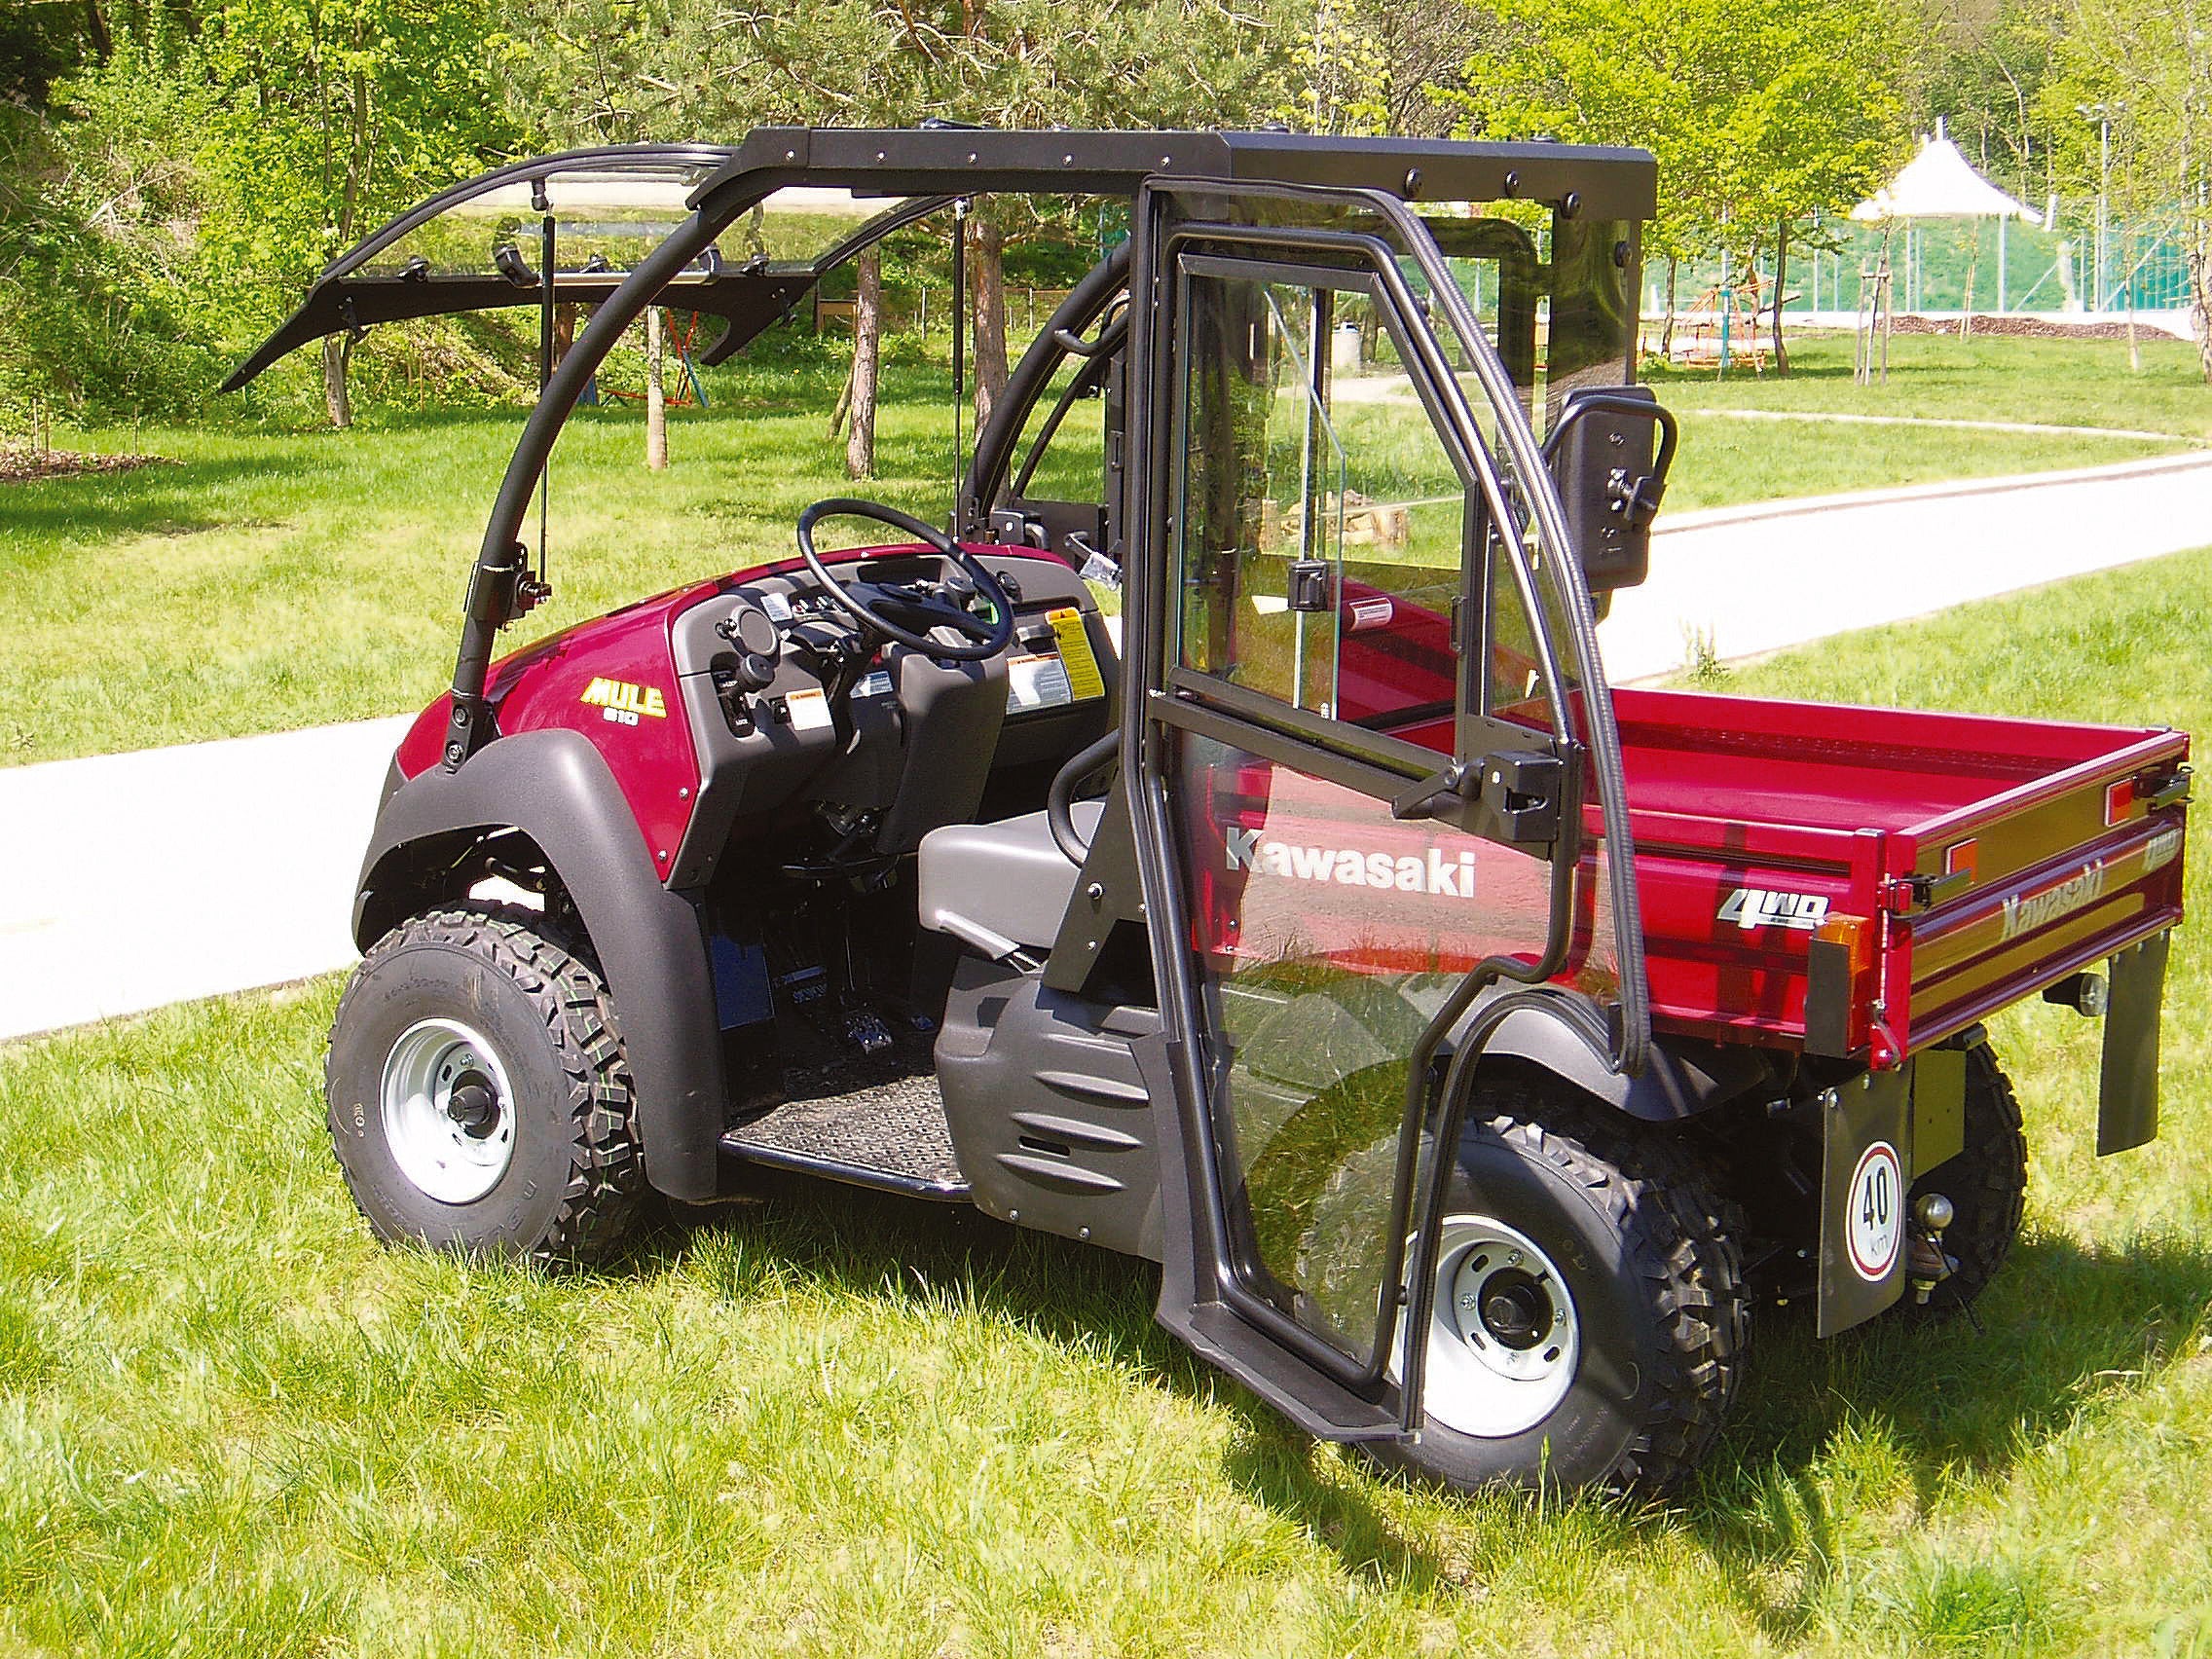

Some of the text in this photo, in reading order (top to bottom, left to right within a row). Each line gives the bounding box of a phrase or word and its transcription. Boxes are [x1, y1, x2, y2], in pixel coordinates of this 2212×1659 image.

[579, 677, 668, 719] MULE
[1226, 826, 1476, 898] Kawasaki
[1716, 888, 1828, 929] 4WD
[2002, 857, 2104, 940] Kawasaki
[1863, 1166, 1888, 1231] 40
